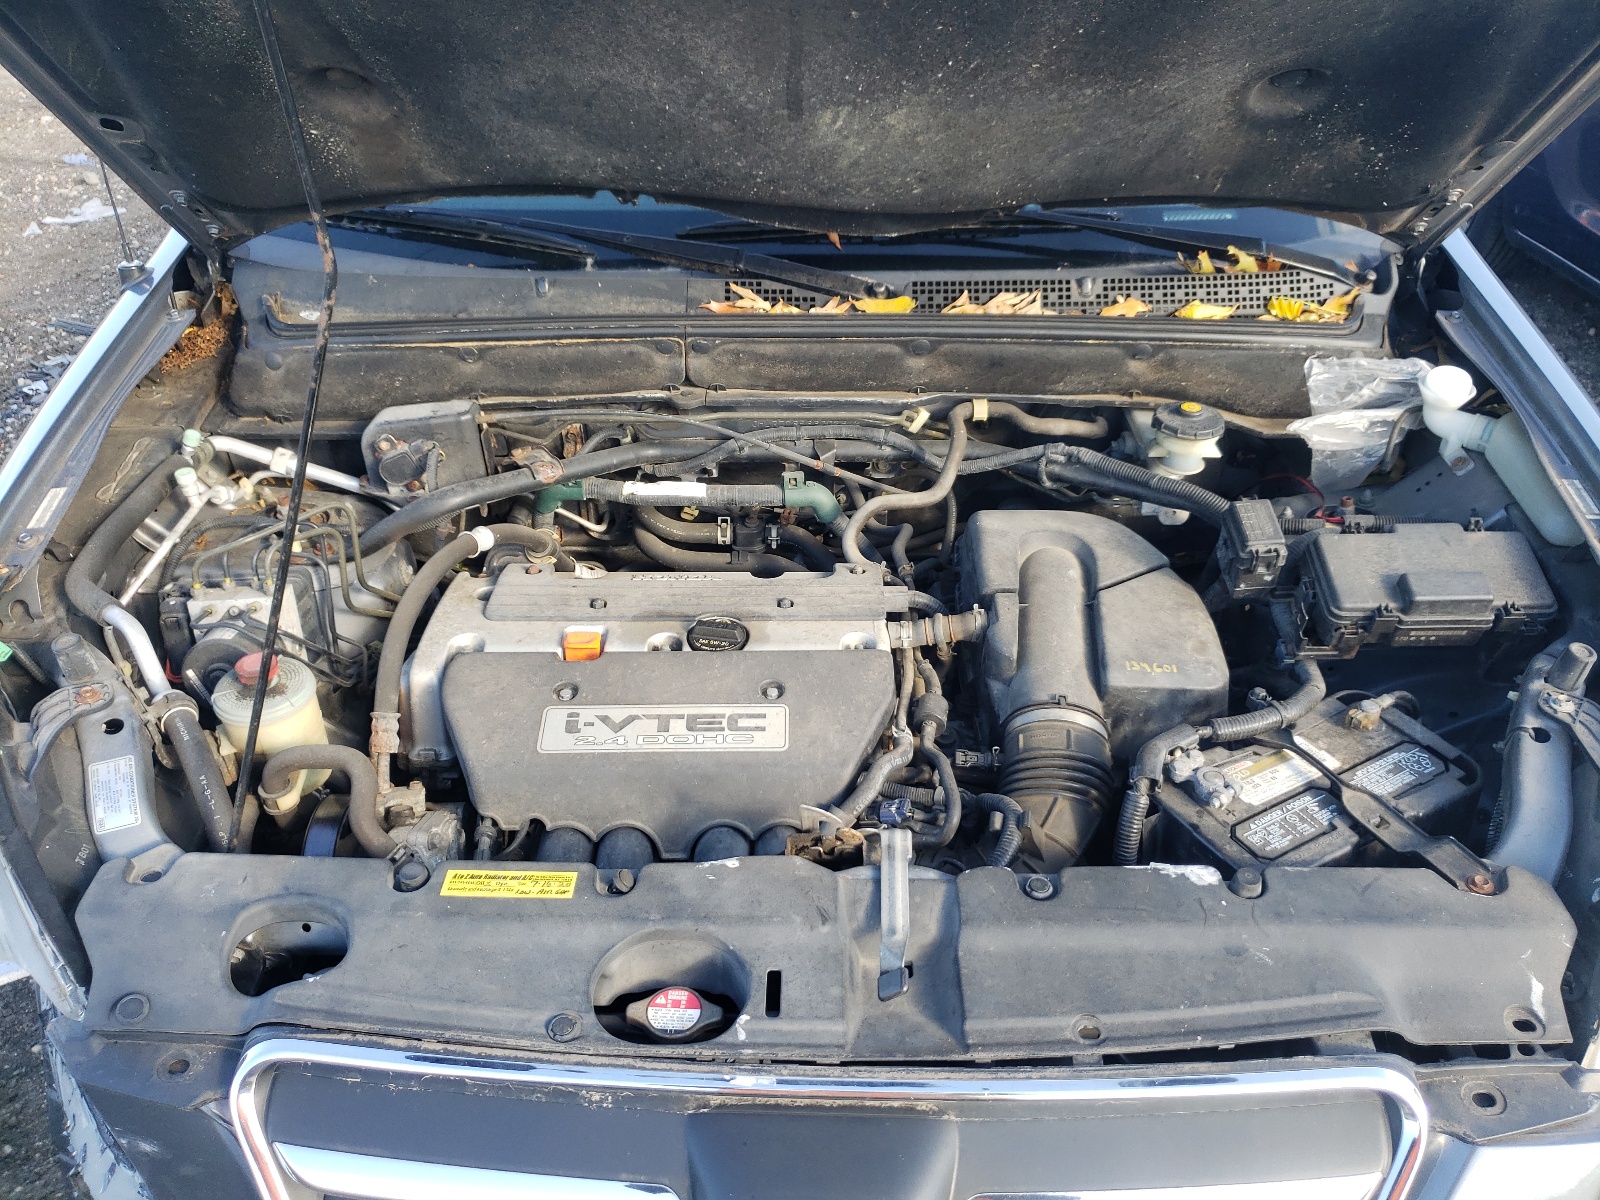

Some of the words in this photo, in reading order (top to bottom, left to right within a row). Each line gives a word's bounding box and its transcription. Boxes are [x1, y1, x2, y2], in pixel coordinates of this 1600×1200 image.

[564, 711, 767, 734] i-VTEC
[573, 735, 629, 746] 2.4
[635, 733, 755, 746] DOHC
[1254, 808, 1283, 826] DANGER
[1286, 795, 1313, 811] POISON
[483, 873, 510, 881] Radiator
